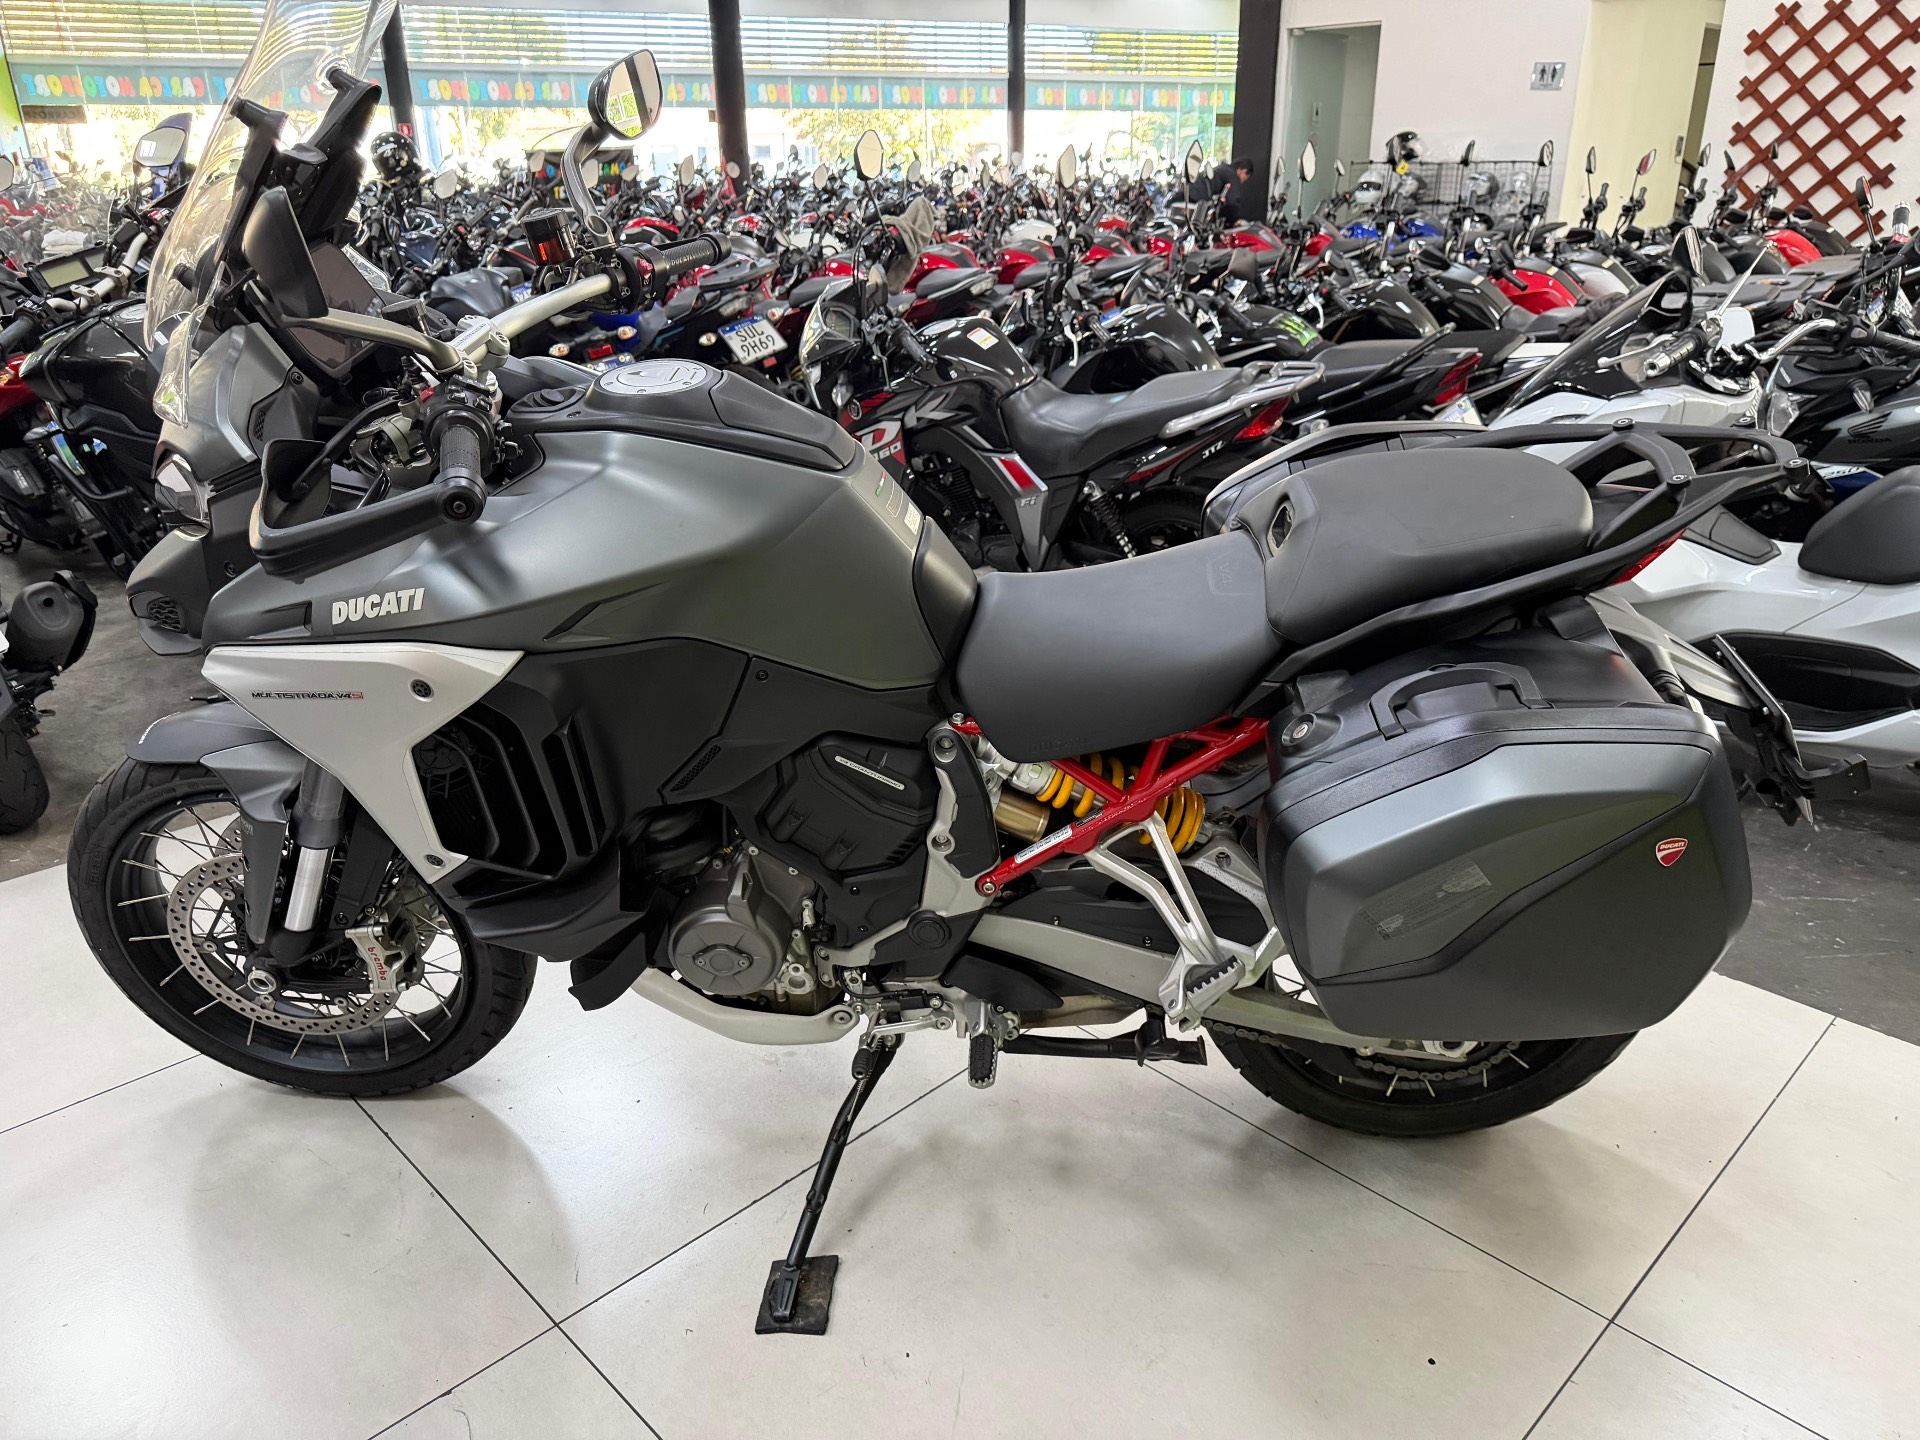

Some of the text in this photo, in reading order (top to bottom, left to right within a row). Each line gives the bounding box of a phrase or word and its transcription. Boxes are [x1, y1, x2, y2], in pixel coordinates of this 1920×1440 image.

[740, 334, 776, 357] 9H69
[331, 587, 426, 626] DUCATI
[250, 690, 334, 700] MULTISTRADA
[1659, 841, 1686, 850] DUCATI
[367, 946, 389, 981] brembo
